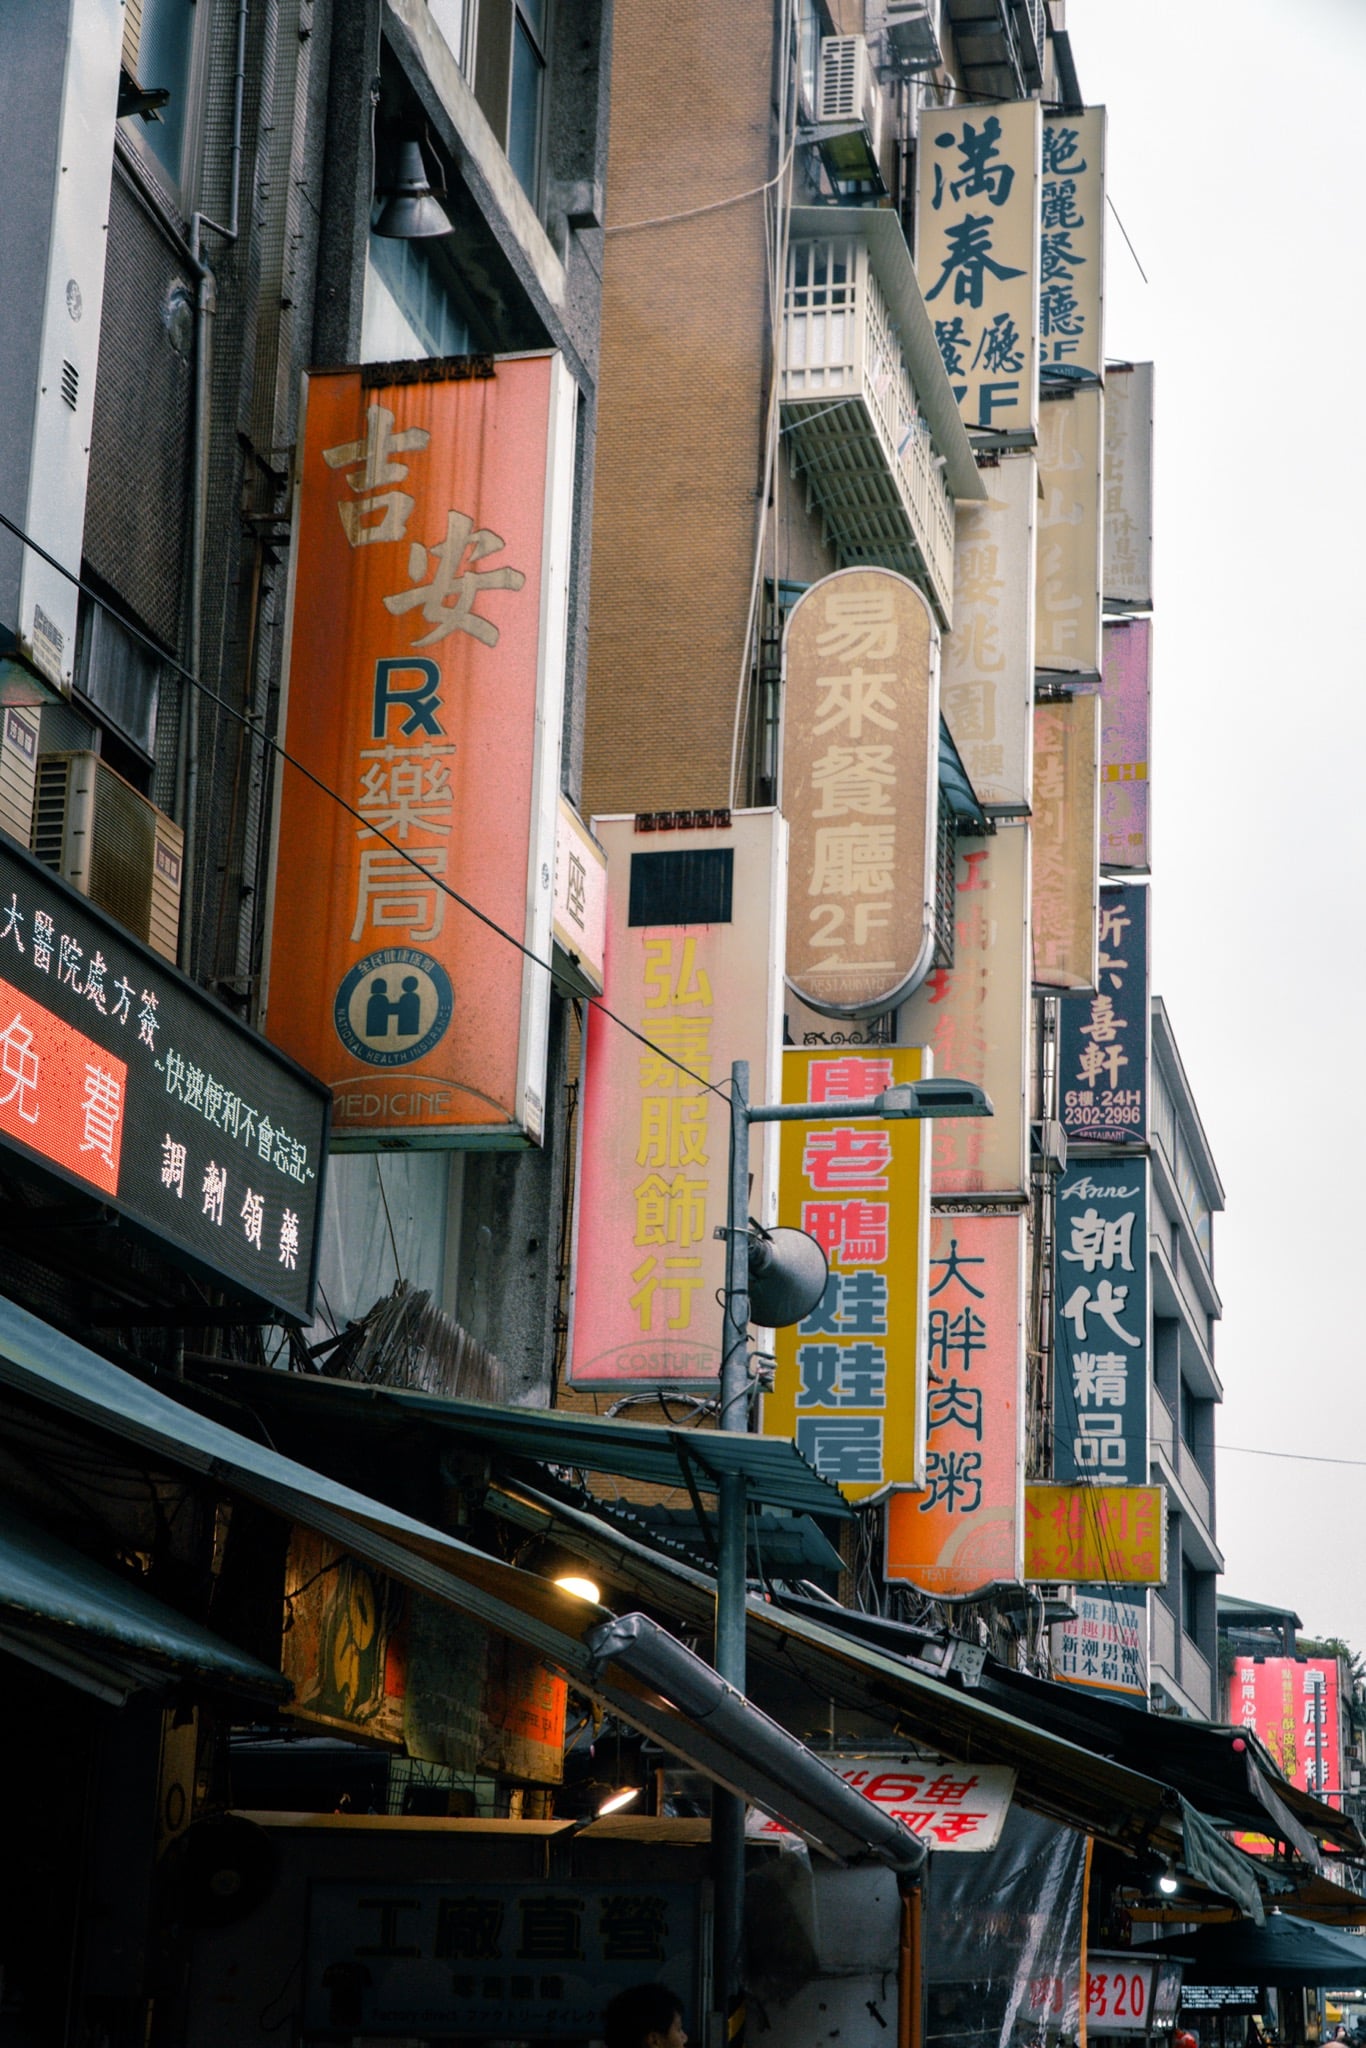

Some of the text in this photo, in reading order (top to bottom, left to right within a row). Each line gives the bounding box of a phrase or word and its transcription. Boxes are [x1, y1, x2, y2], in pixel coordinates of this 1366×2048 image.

[925, 116, 1027, 308] 滿春
[322, 404, 526, 648] 吉安
[810, 590, 898, 896] 易來餐廳
[349, 743, 456, 944] 藥局
[809, 902, 893, 948] 2F
[0, 1013, 121, 1170] 免費
[336, 1004, 452, 1064] NATIONAL HEALTH INSURANCE
[630, 937, 713, 1333] 弘嘉服飾行
[1065, 1107, 1141, 1124] 2302-2996
[161, 1133, 299, 1270] 調劑領藥
[1061, 1177, 1140, 1200] Anne
[615, 1351, 713, 1373] COSTUME
[919, 1239, 986, 1513] 大胖肉粥
[1060, 1208, 1142, 1484] 朝代精品
[1062, 1655, 1138, 1685] 日本精品
[353, 1894, 670, 1962] 工廠直營
[465, 2006, 608, 2024] ファクトリーダイレク
